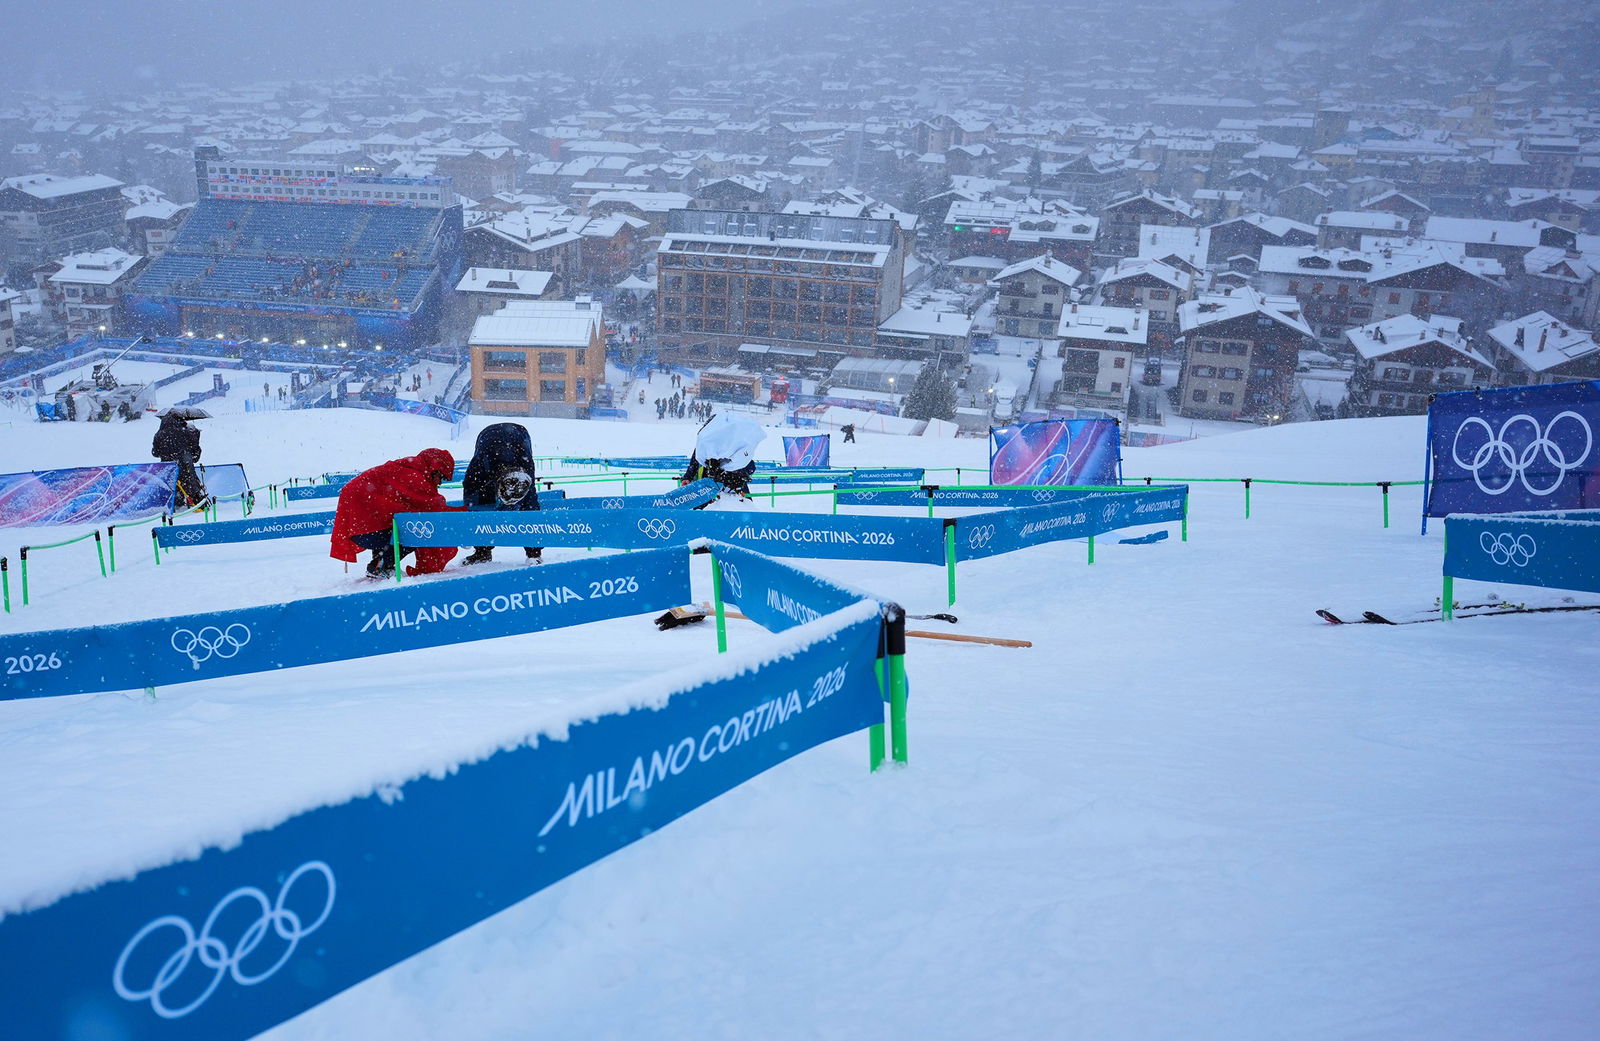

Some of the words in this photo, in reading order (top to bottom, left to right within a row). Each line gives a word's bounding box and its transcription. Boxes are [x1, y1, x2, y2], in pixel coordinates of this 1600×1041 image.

[243, 525, 282, 535] MILANO
[284, 521, 324, 531] CORTINA
[475, 524, 516, 534] MILANO
[518, 524, 566, 534] CORTINA
[568, 524, 592, 534] 2026
[730, 527, 790, 541] MILANO
[792, 530, 860, 544] CORTINA
[862, 532, 895, 544] 2026
[1019, 520, 1048, 538] MILANO
[1047, 516, 1072, 529] CORTINA
[1072, 512, 1086, 524] 2026
[360, 602, 468, 632] MILANO
[474, 586, 584, 614] CORTINA
[588, 576, 640, 599] 2026
[4, 652, 62, 674] 2026
[538, 737, 695, 836] MILANO
[698, 690, 802, 762] CORTINA
[806, 662, 849, 708] 2026
